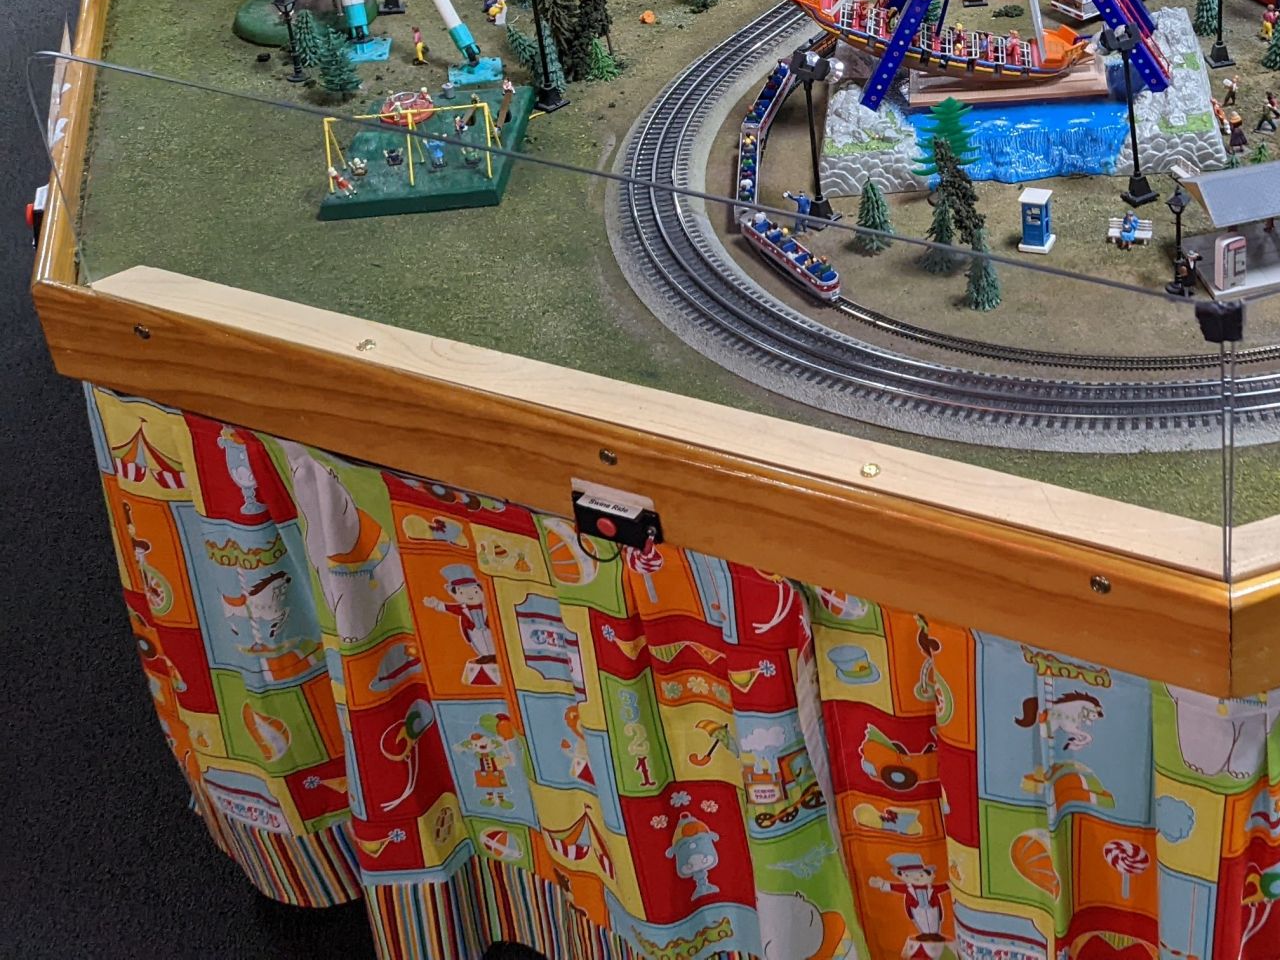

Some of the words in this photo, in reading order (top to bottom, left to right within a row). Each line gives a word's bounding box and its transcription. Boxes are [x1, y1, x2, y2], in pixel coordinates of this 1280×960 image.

[611, 503, 629, 513] Ride
[618, 688, 640, 723] 3
[623, 723, 650, 756] 2
[635, 755, 657, 786] 1
